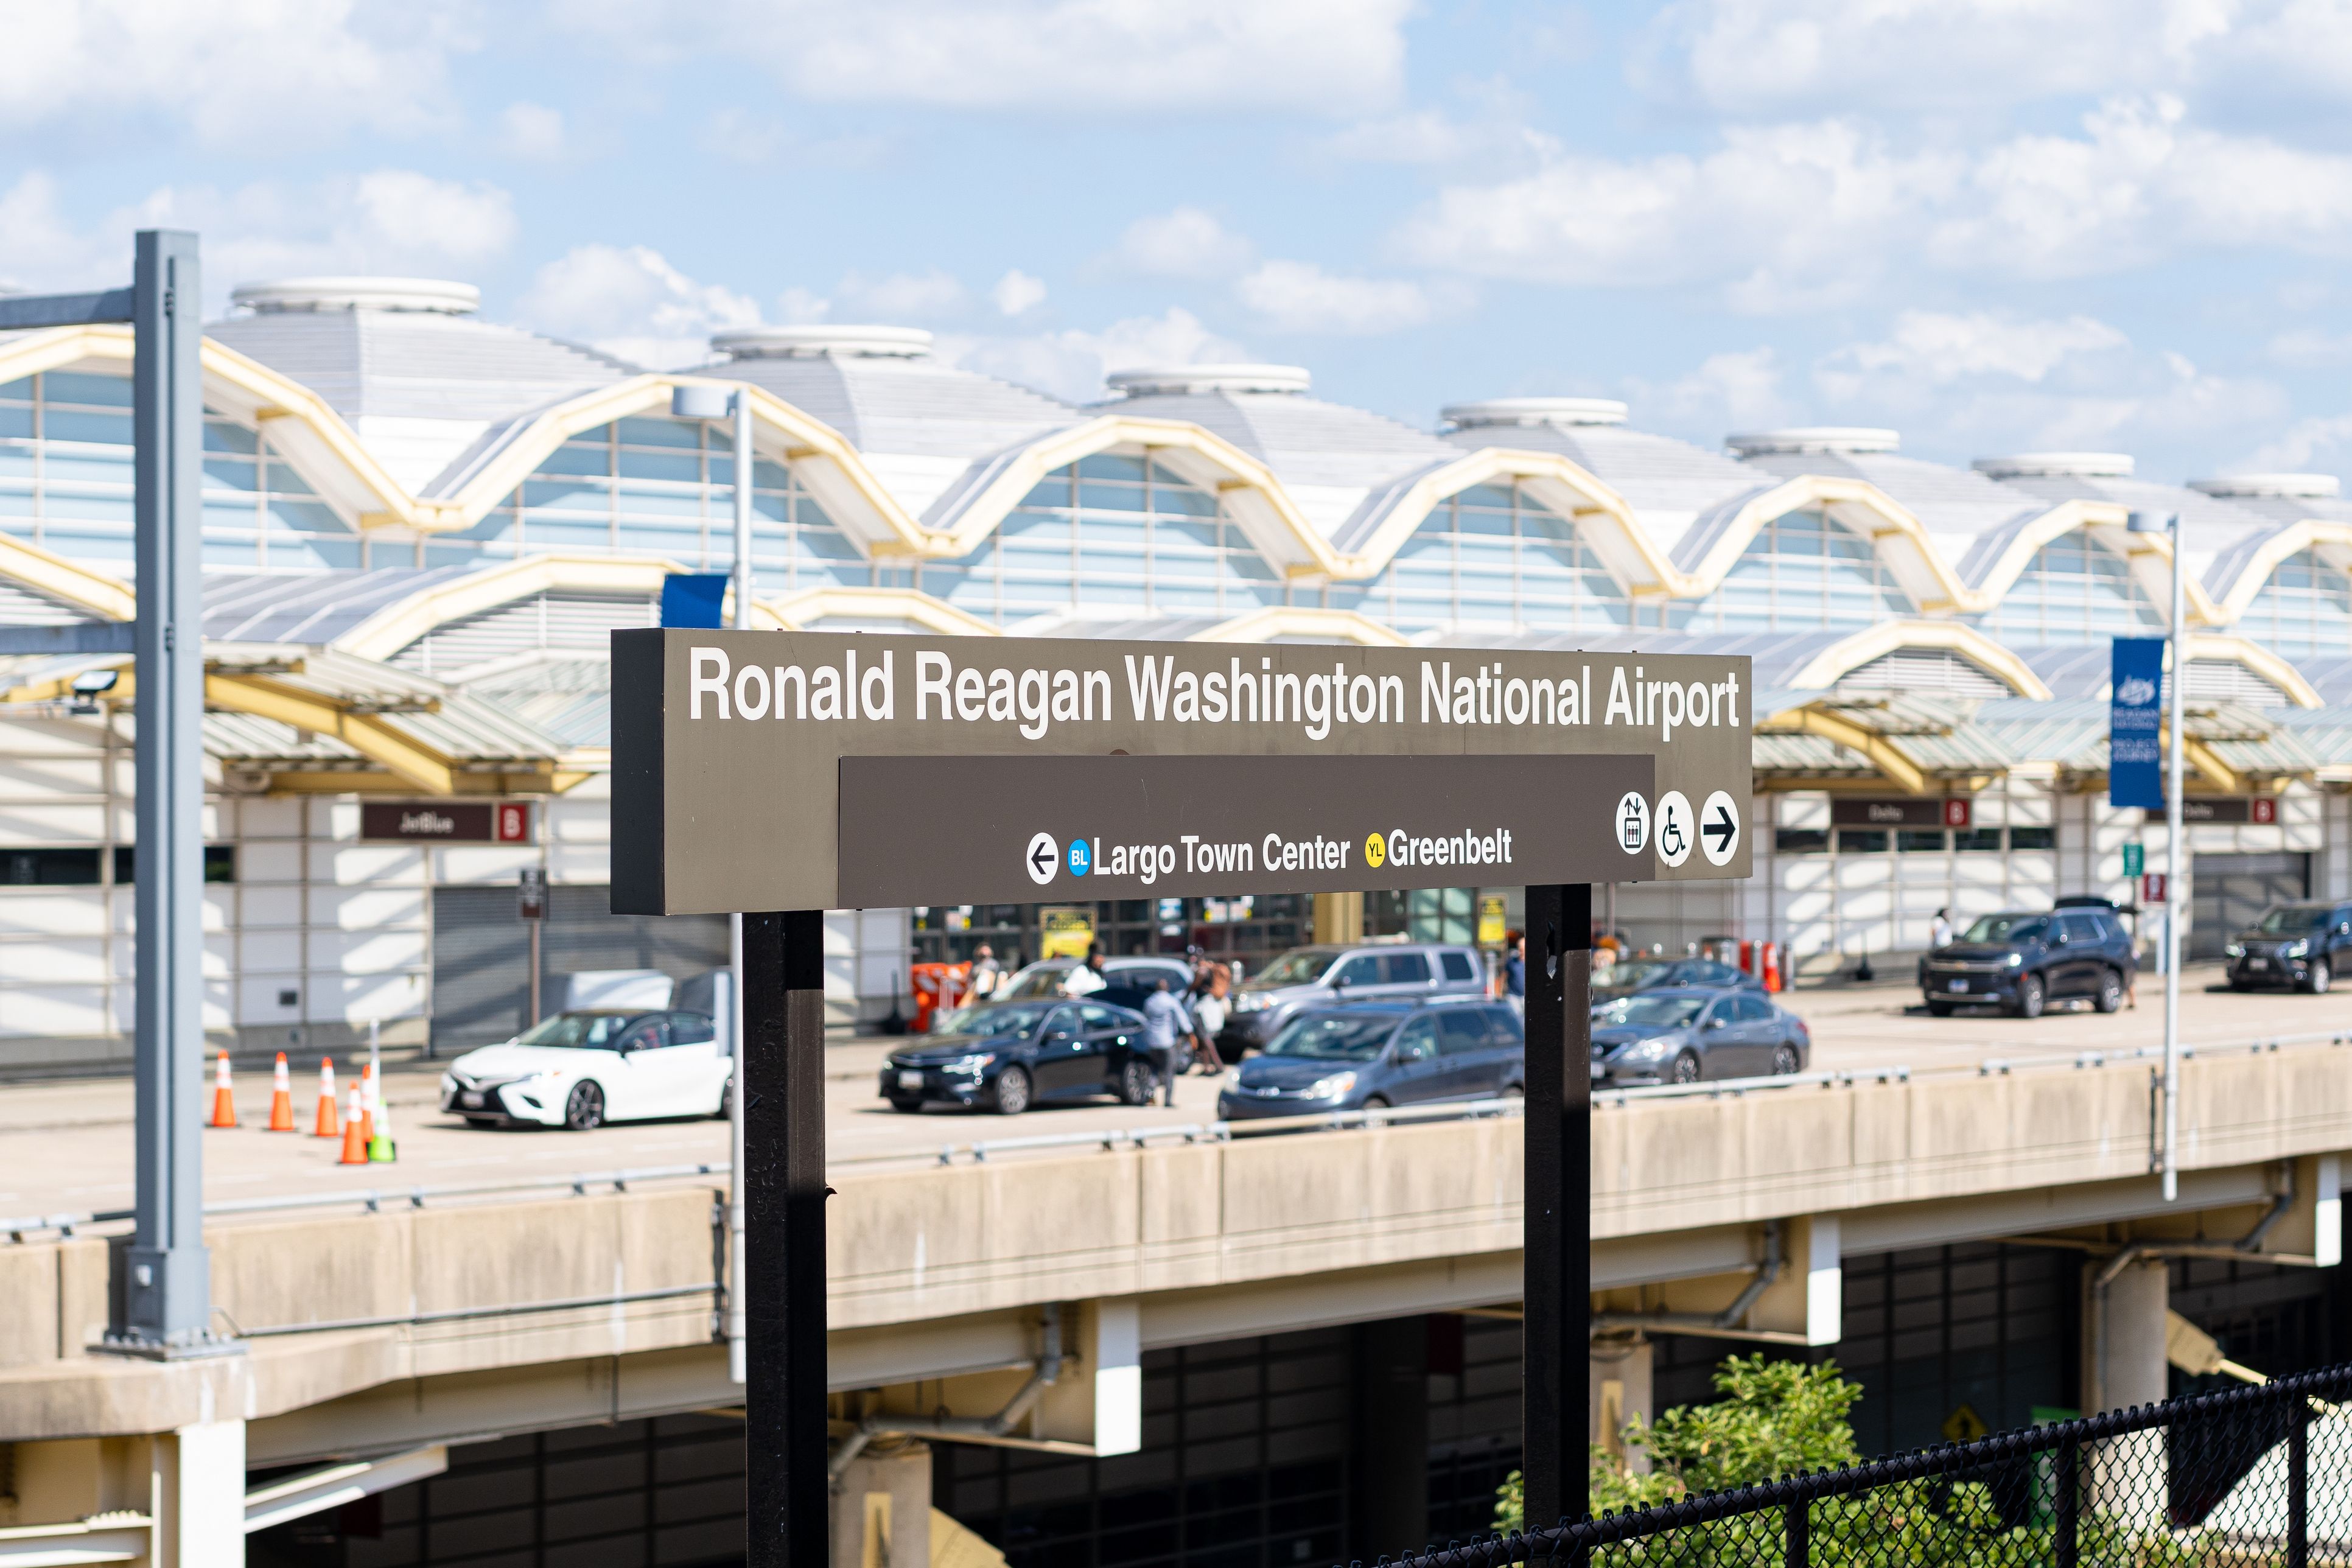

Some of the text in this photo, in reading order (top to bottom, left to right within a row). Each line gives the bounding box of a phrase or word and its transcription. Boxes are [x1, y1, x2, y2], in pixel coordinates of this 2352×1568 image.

[690, 647, 1740, 742] Ronald Reagan Washington National Airport
[399, 808, 520, 838] JetBlue B
[1950, 801, 1964, 824] B
[2256, 800, 2271, 822] B
[1071, 828, 1512, 884] BL Largo Town Center YL Greenbelt
